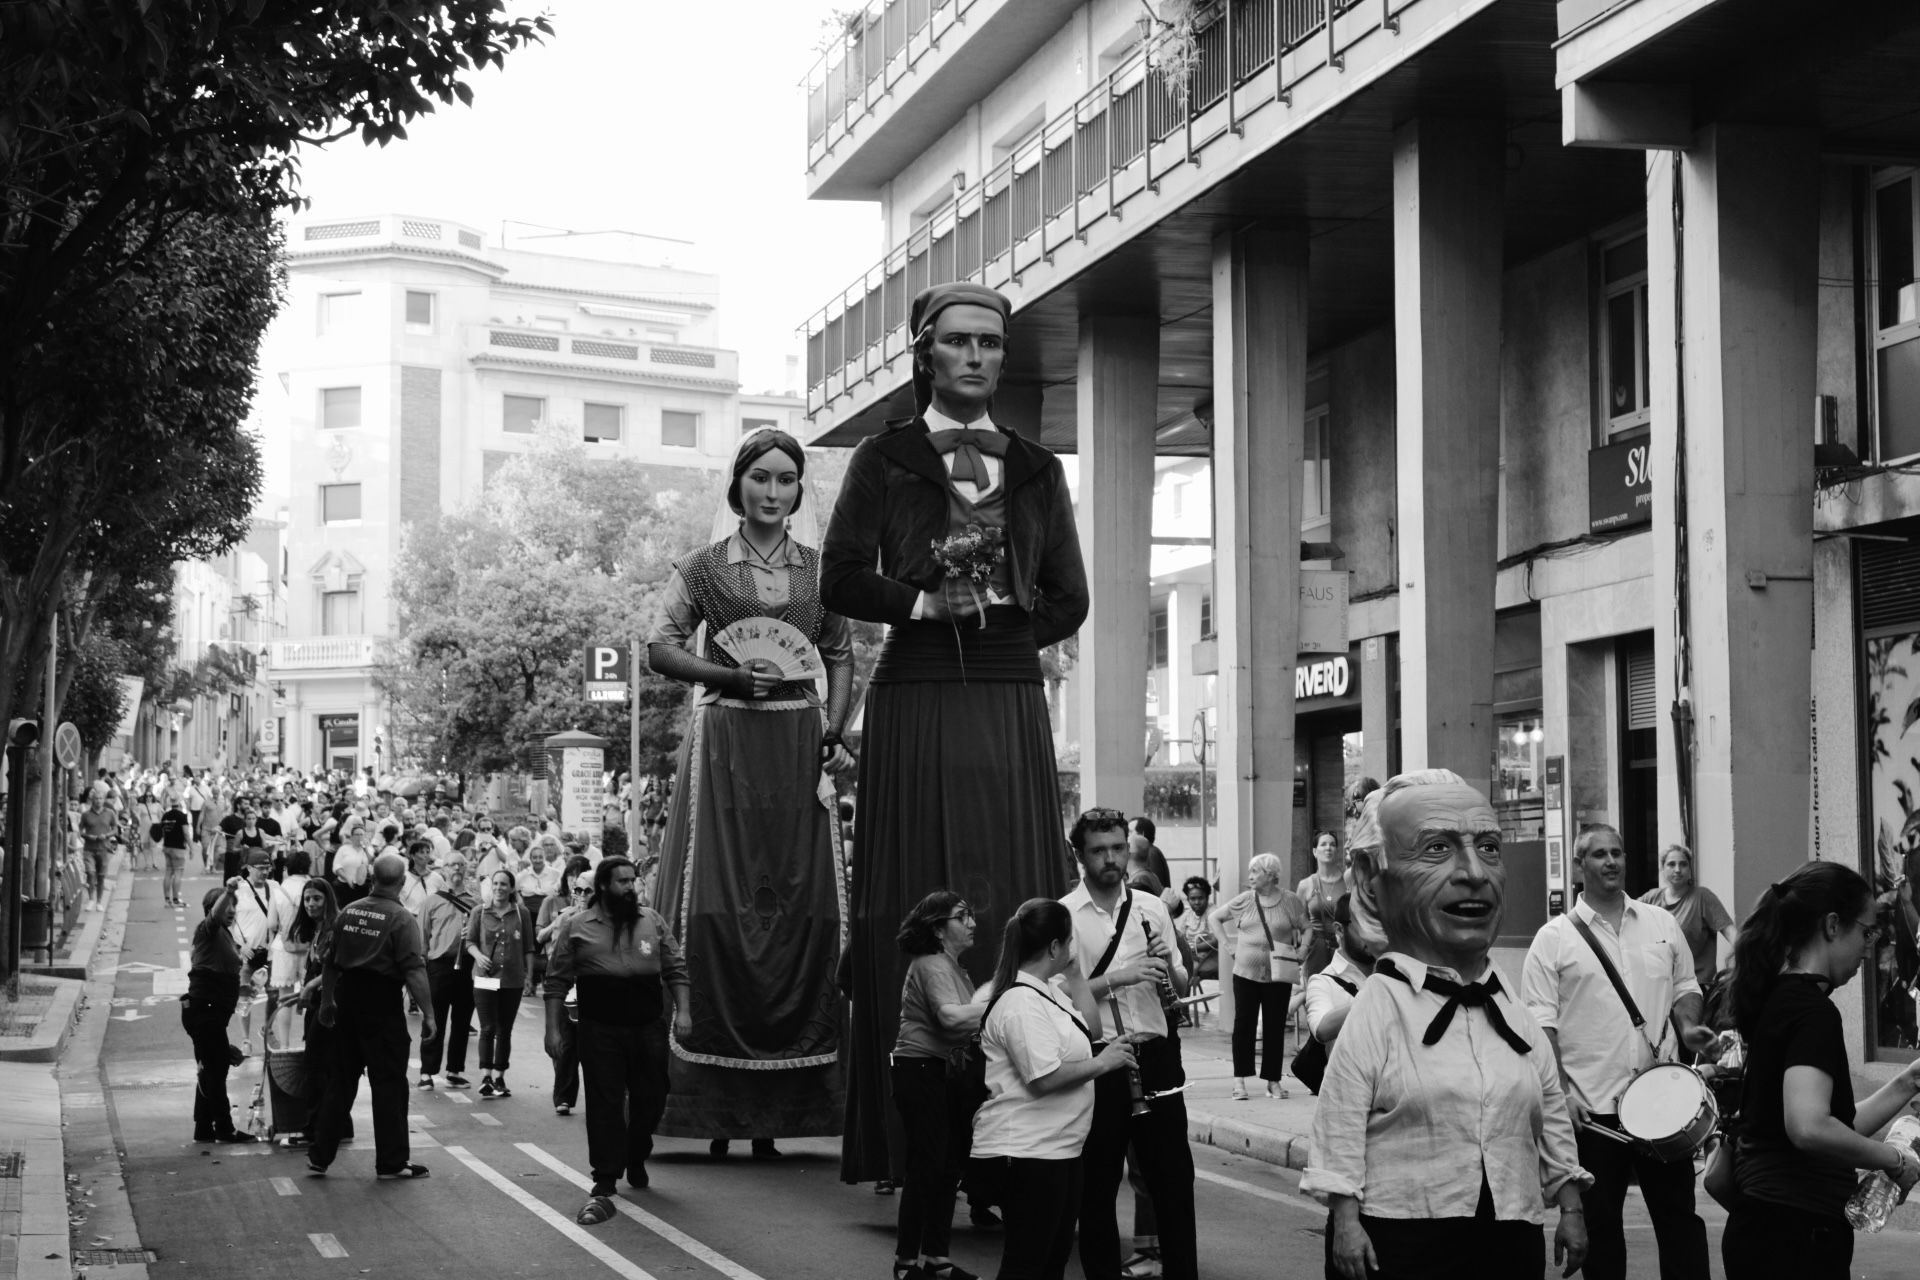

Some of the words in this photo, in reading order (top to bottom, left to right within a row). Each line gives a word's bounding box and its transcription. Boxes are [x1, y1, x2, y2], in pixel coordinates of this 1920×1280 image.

[1300, 586, 1334, 601] FAUS
[595, 647, 618, 679] P
[1295, 656, 1348, 698] RVERD
